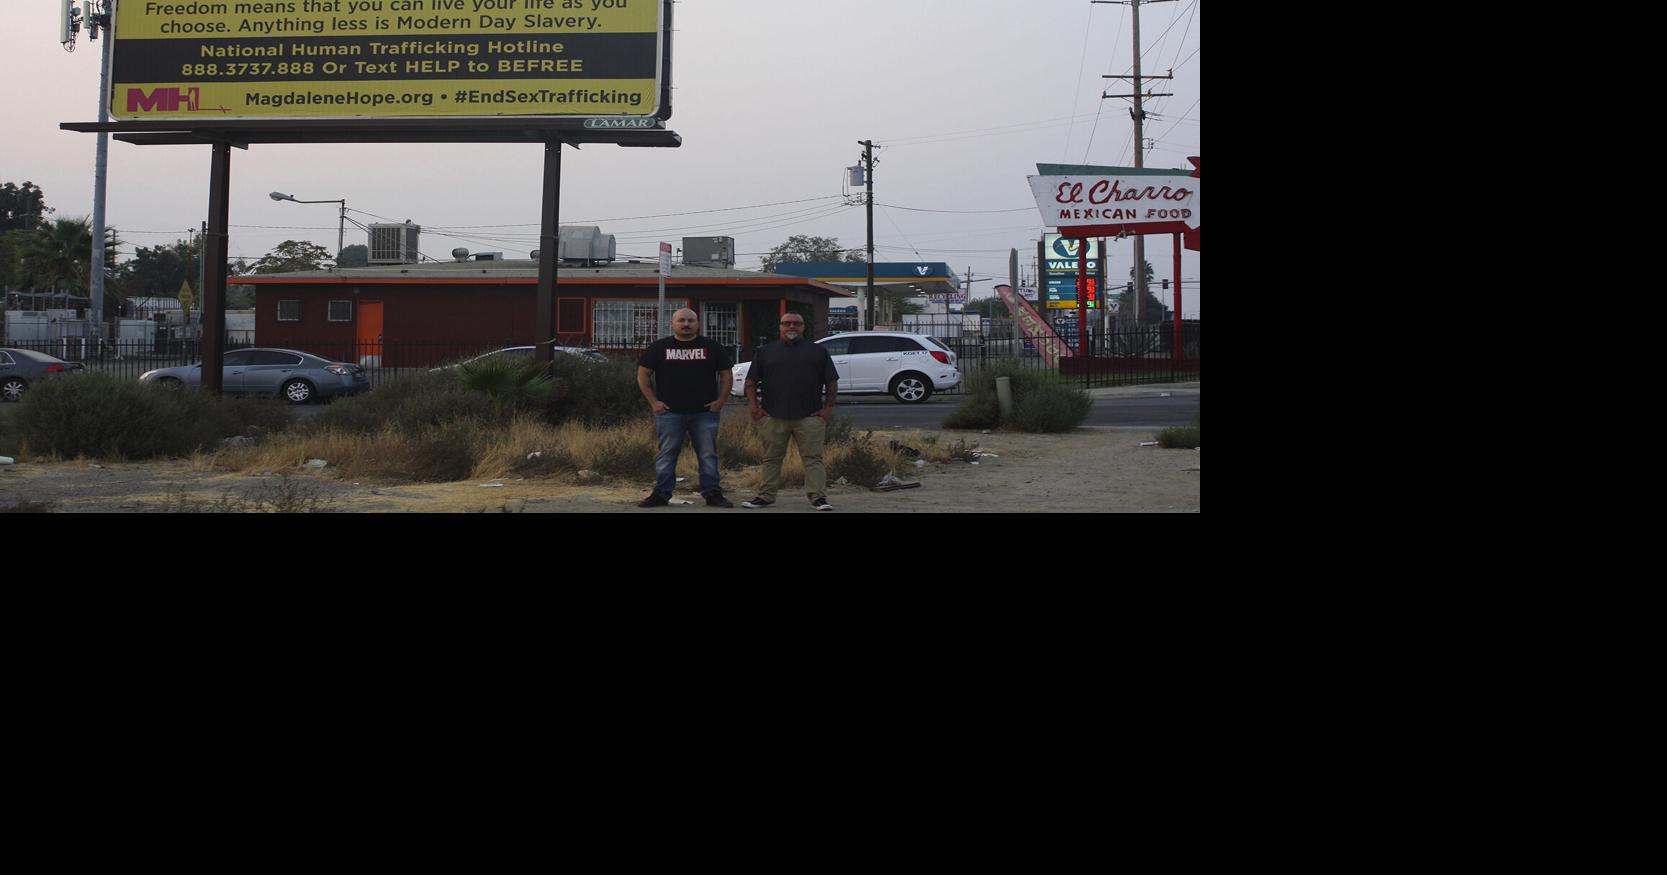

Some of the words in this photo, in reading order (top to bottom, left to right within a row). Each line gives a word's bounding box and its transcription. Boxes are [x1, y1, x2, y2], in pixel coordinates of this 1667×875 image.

[145, 0, 228, 15] Freedom
[235, 1, 296, 14] means
[303, 0, 340, 13] that
[348, 0, 383, 16] you
[390, 1, 424, 11] can
[432, 0, 468, 11] live
[472, 0, 516, 13] your
[524, 0, 555, 9] life
[562, 0, 583, 9] as
[591, 0, 627, 11] you
[160, 20, 231, 33] choose.
[238, 17, 325, 34] Anything
[332, 17, 368, 31] less
[375, 16, 389, 30] is
[397, 15, 471, 30] Modern
[479, 15, 517, 30] Day
[524, 14, 602, 30] Slavery.
[200, 43, 283, 57] National
[291, 42, 361, 56] Human
[369, 41, 480, 56] Trafficking
[487, 40, 564, 54] Hotline
[181, 62, 314, 76] 888.3737.888
[322, 61, 346, 74] Or
[355, 60, 398, 74] Text
[405, 60, 461, 73] HELP
[467, 60, 489, 73] to
[497, 59, 584, 72] BEFREE
[245, 91, 433, 107] MagdaleneHope.org
[454, 89, 642, 106] #EndSexTrafficking
[588, 118, 649, 128] LAMAR
[1055, 181, 1084, 204] El
[1088, 179, 1194, 205] Charro
[1059, 208, 1137, 220] MEXICAN
[1145, 208, 1193, 219] FOOD
[1048, 261, 1096, 269] VALEO
[666, 348, 706, 360] MARVEL
